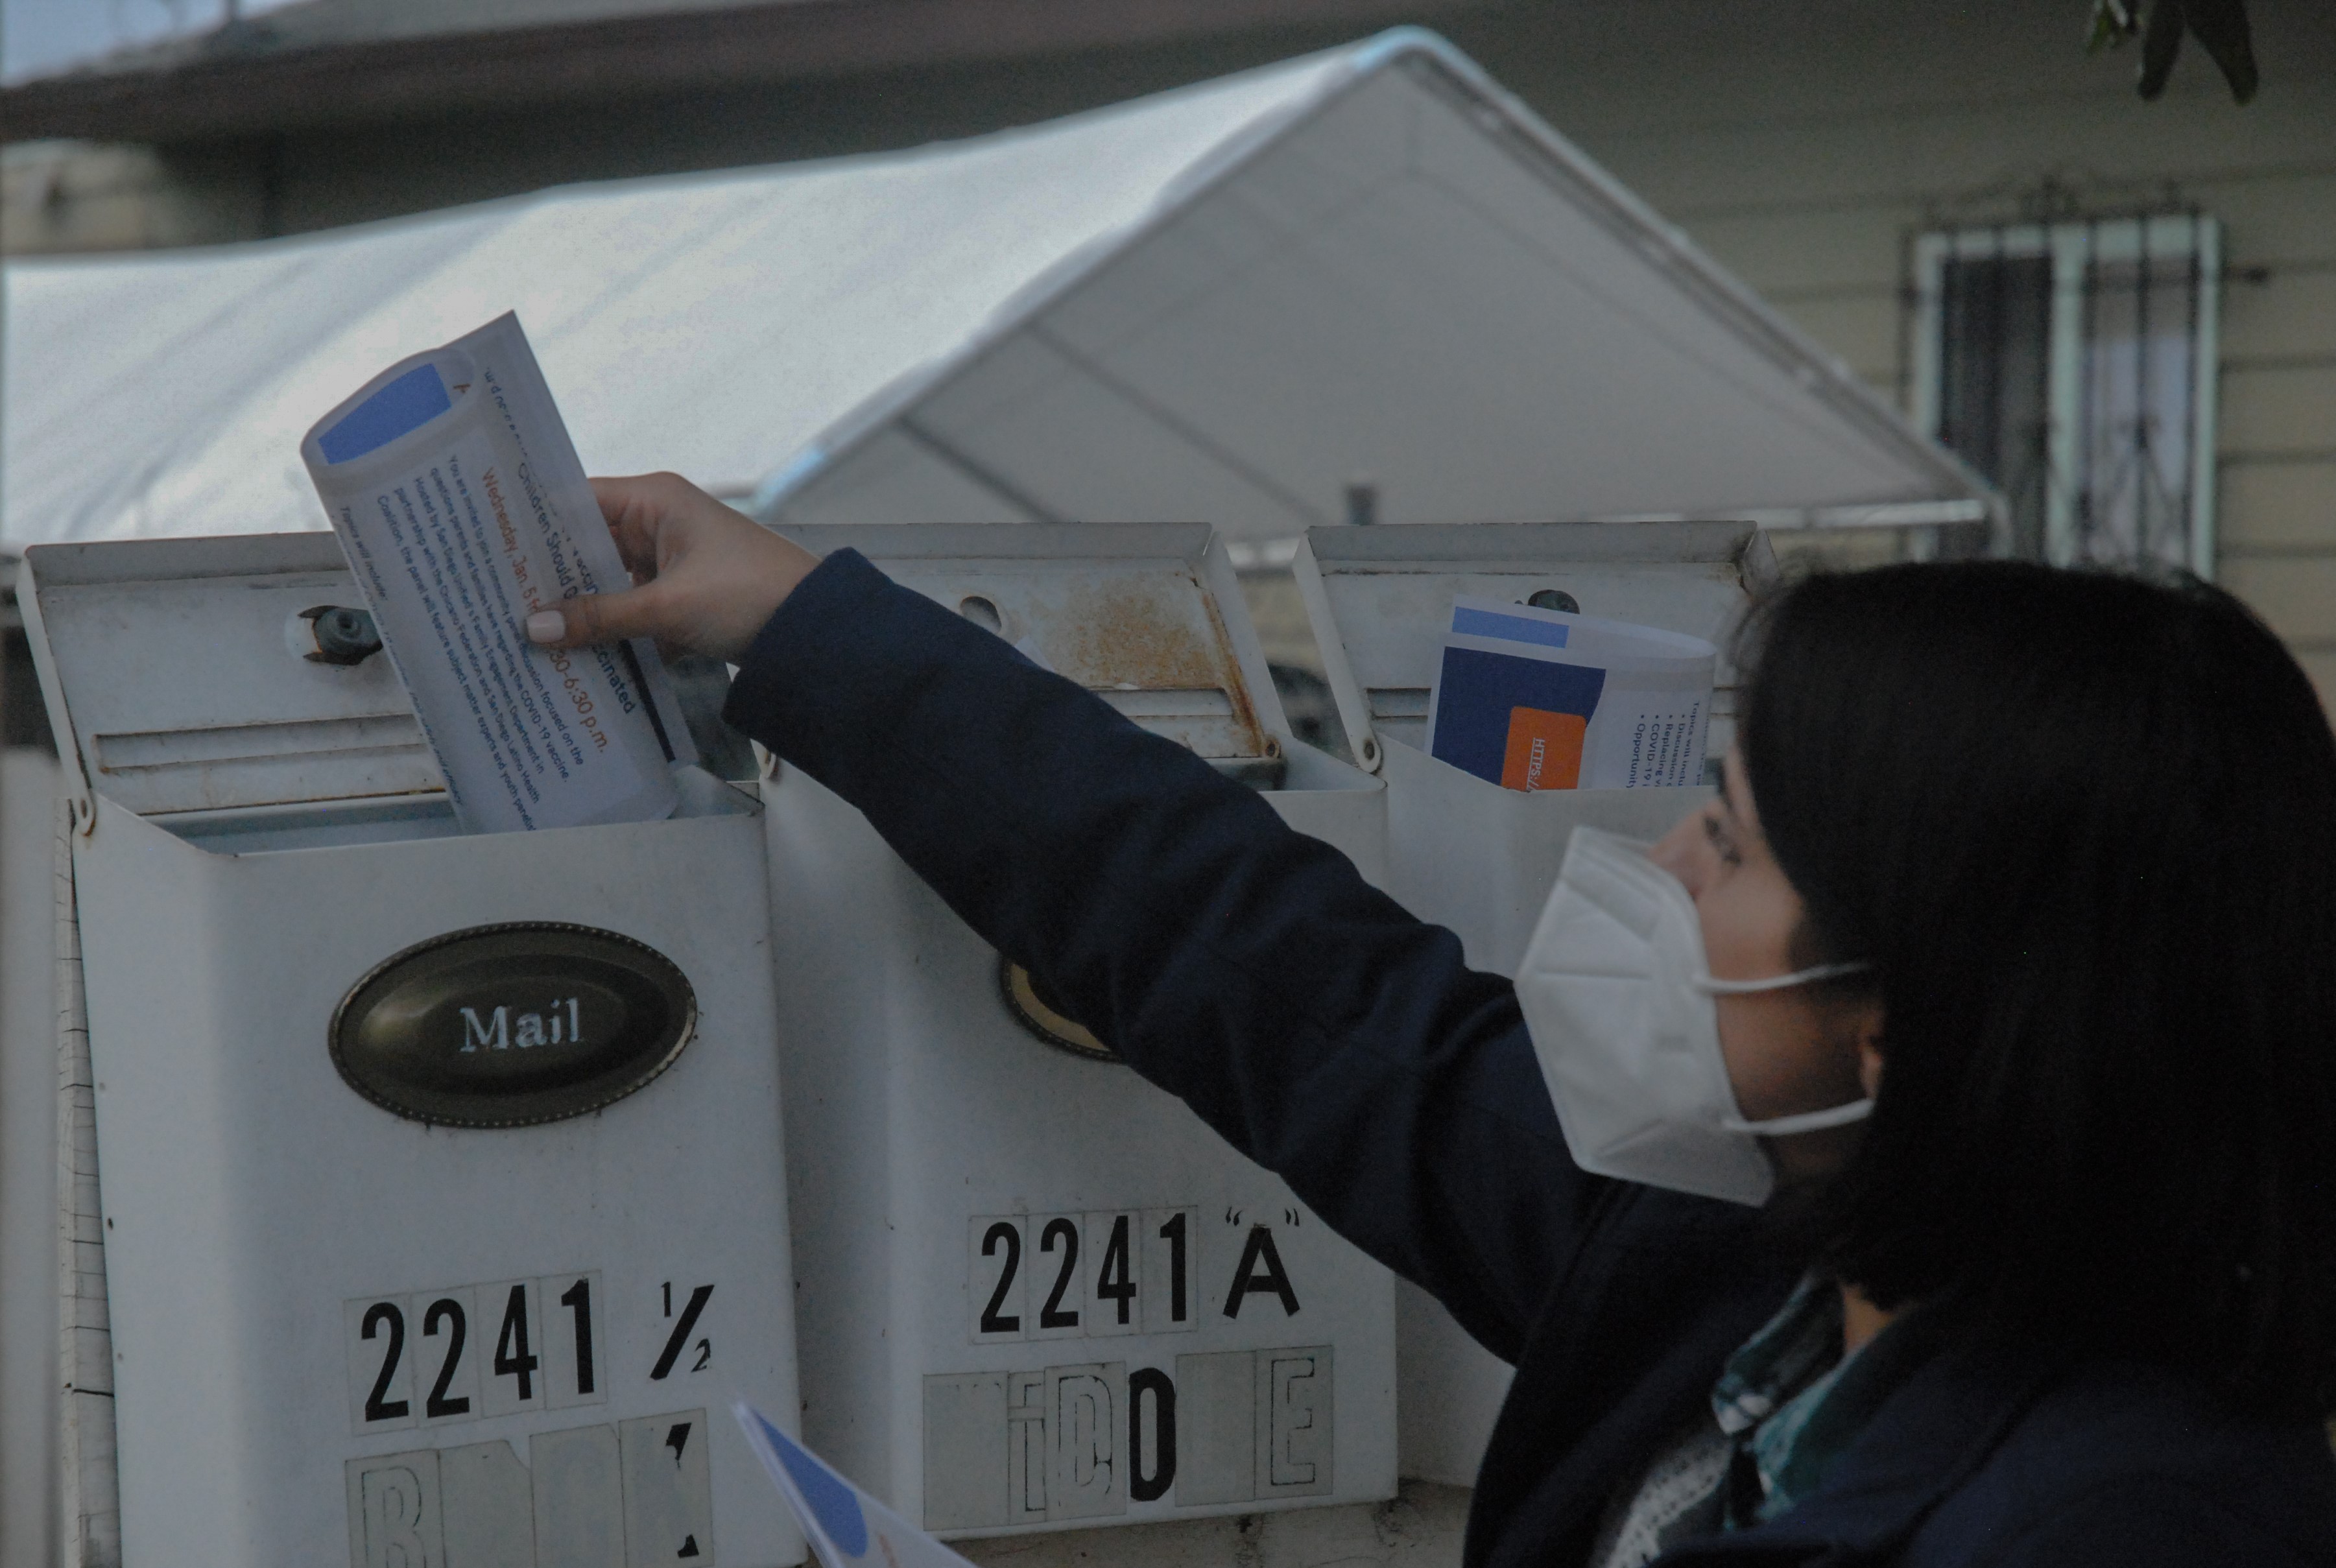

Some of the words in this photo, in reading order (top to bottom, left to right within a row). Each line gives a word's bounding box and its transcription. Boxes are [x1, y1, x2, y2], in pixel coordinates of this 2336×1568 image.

[339, 506, 360, 538] Topics
[355, 540, 372, 558] will
[377, 495, 403, 546] Coalition,
[399, 547, 414, 564] the
[406, 566, 428, 593] panel
[545, 532, 573, 586] Should
[413, 477, 436, 514] Hosted
[429, 514, 441, 528] by
[435, 527, 448, 548] San
[443, 547, 457, 575] Diego
[471, 615, 489, 648] Family
[485, 648, 513, 706] Engagement
[509, 706, 540, 762] Department
[534, 761, 545, 774] in
[422, 595, 436, 613] will
[429, 468, 455, 515] questions
[449, 516, 468, 550] parents
[463, 551, 476, 569] and
[470, 567, 488, 606] families
[485, 604, 499, 629] have
[494, 630, 518, 676] regarding
[510, 672, 523, 691] the
[520, 690, 551, 739] COVID-19
[545, 741, 569, 781] vaccine.
[431, 612, 451, 648] feature
[447, 455, 460, 477] You
[455, 478, 468, 495] are
[462, 493, 481, 527] invited
[487, 565, 510, 615] community
[505, 616, 523, 641] panel
[519, 641, 544, 691] discussion
[540, 691, 568, 731] focused
[561, 732, 574, 746] on
[569, 746, 584, 765] the
[482, 467, 518, 559] Wednesday,
[512, 556, 528, 586] Jan.
[578, 716, 607, 752] p.m.
[393, 487, 426, 545] partnership
[422, 546, 436, 568] with
[432, 568, 443, 586] the
[457, 624, 483, 676] Federation
[478, 677, 492, 696] and
[487, 695, 499, 713] San
[494, 713, 510, 741] Diego
[507, 741, 523, 771] Latino
[520, 770, 540, 803] Health
[446, 648, 468, 684] subject
[462, 684, 481, 715] matter
[1688, 700, 1700, 736] Topics
[477, 717, 497, 751] experts
[1643, 723, 1660, 781] COVID-19
[1655, 724, 1674, 777] Replacing
[1669, 723, 1686, 780] Discussion
[1684, 739, 1692, 757] will
[492, 752, 507, 770] and
[499, 770, 518, 798] youth
[460, 997, 584, 1053] Mail
[980, 1212, 1187, 1334] 2241
[361, 1277, 595, 1421] 2241
